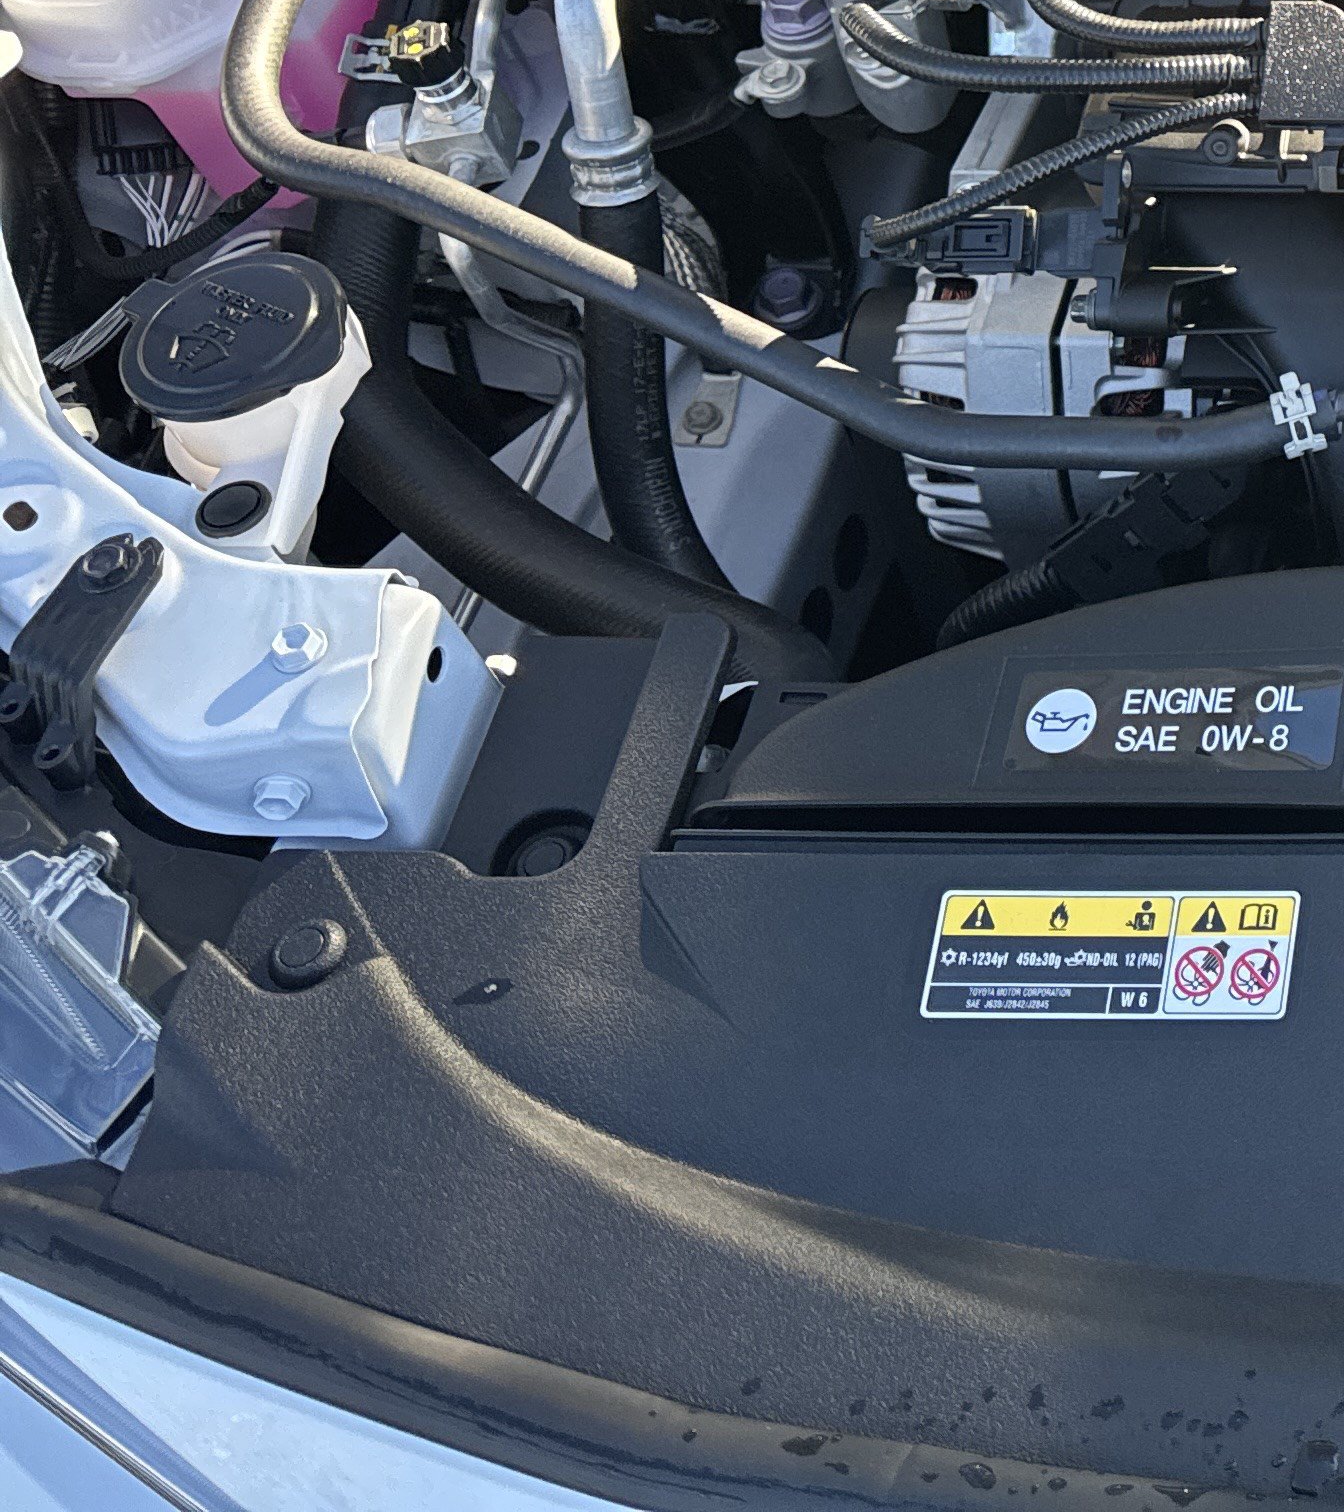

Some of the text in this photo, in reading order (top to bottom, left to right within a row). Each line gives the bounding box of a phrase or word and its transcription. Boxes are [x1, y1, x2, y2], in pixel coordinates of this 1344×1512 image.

[1122, 685, 1303, 714] ENGINE OIL
[1115, 724, 1289, 752] SAE 0W-8
[958, 951, 1163, 969] R-1234yf 450±30g ND-OIL 12 (PAG)
[969, 987, 1071, 997] TOYOTA MOTOR CORPORATION
[1121, 991, 1148, 1008] W 6
[966, 999, 981, 1008] SAE
